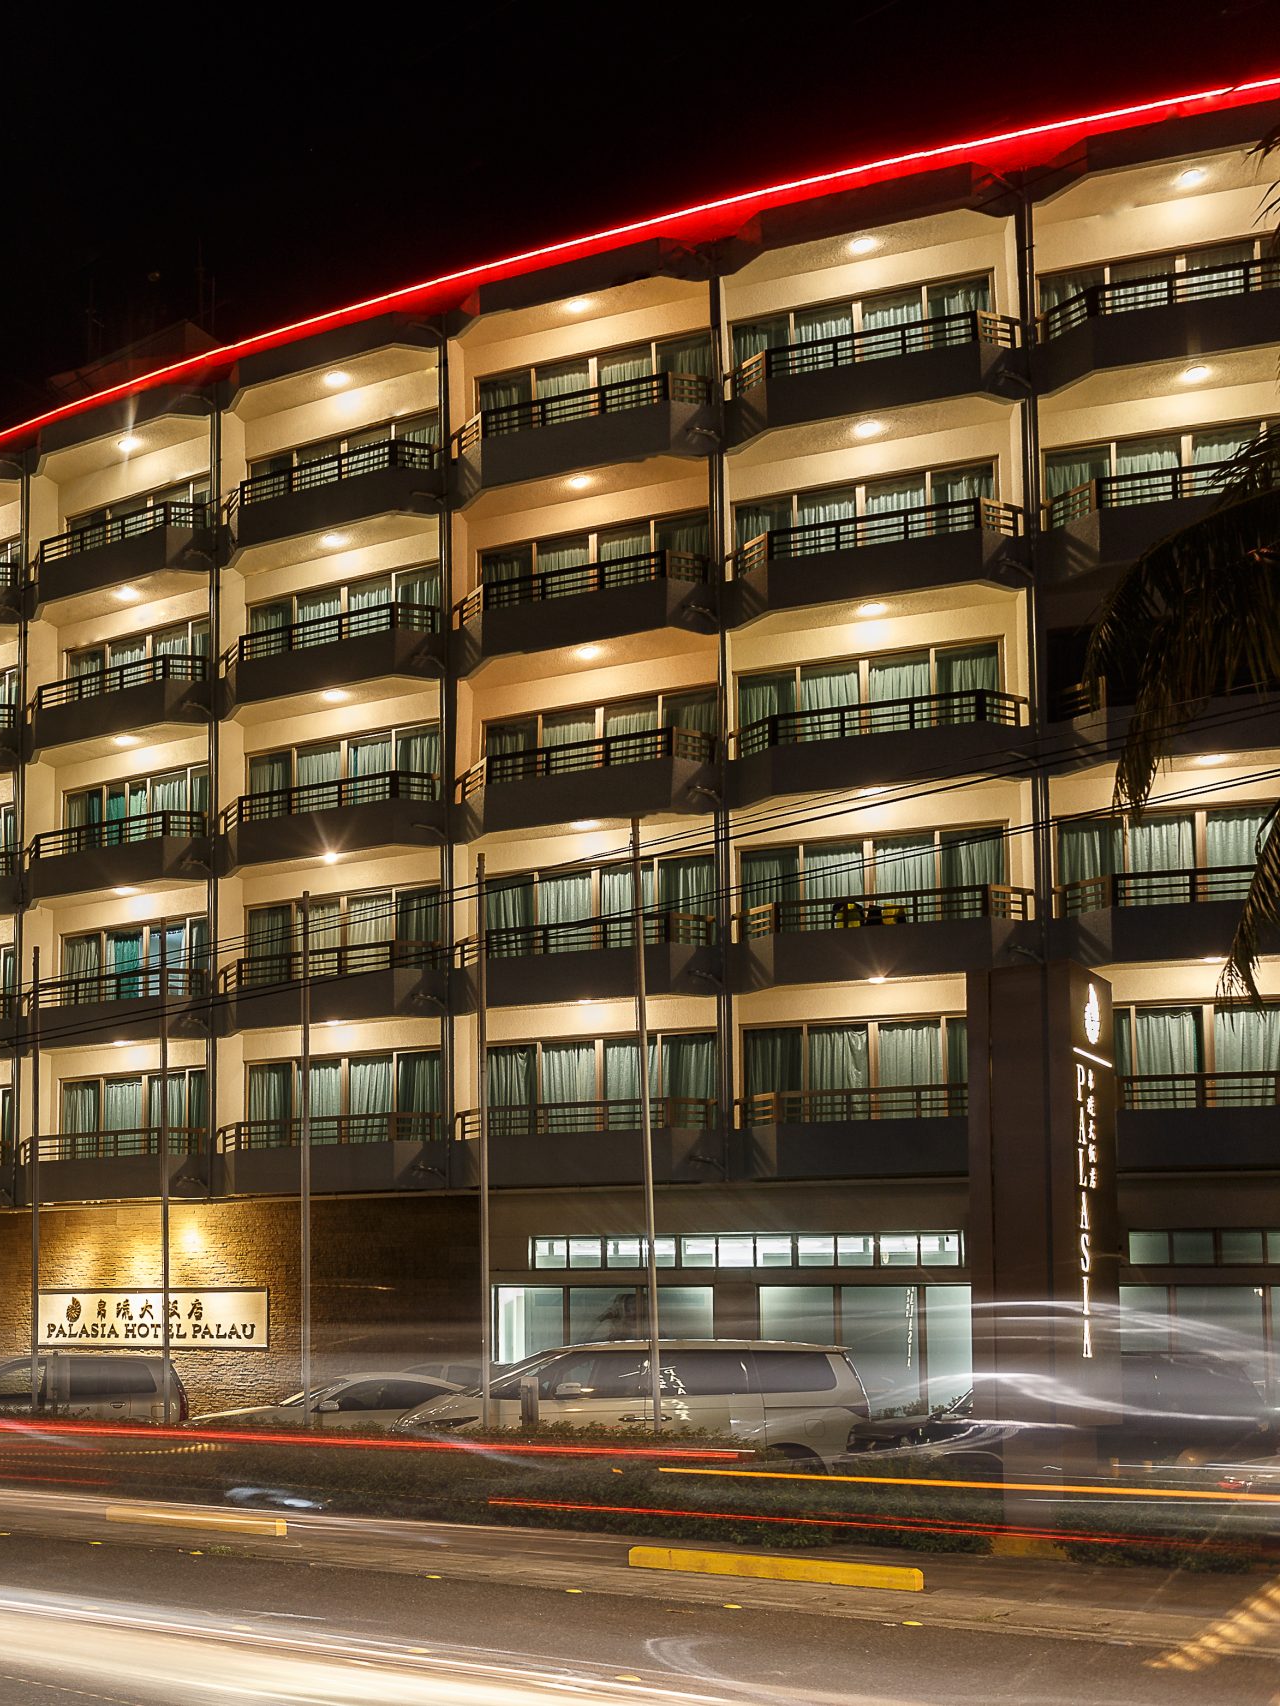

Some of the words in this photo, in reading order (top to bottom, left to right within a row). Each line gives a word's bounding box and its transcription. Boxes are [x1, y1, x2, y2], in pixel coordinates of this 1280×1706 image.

[1076, 1063, 1093, 1358] PALASIA
[46, 1322, 120, 1339] PALASIA
[124, 1322, 187, 1339] HOTEL
[192, 1323, 257, 1340] PALAU
